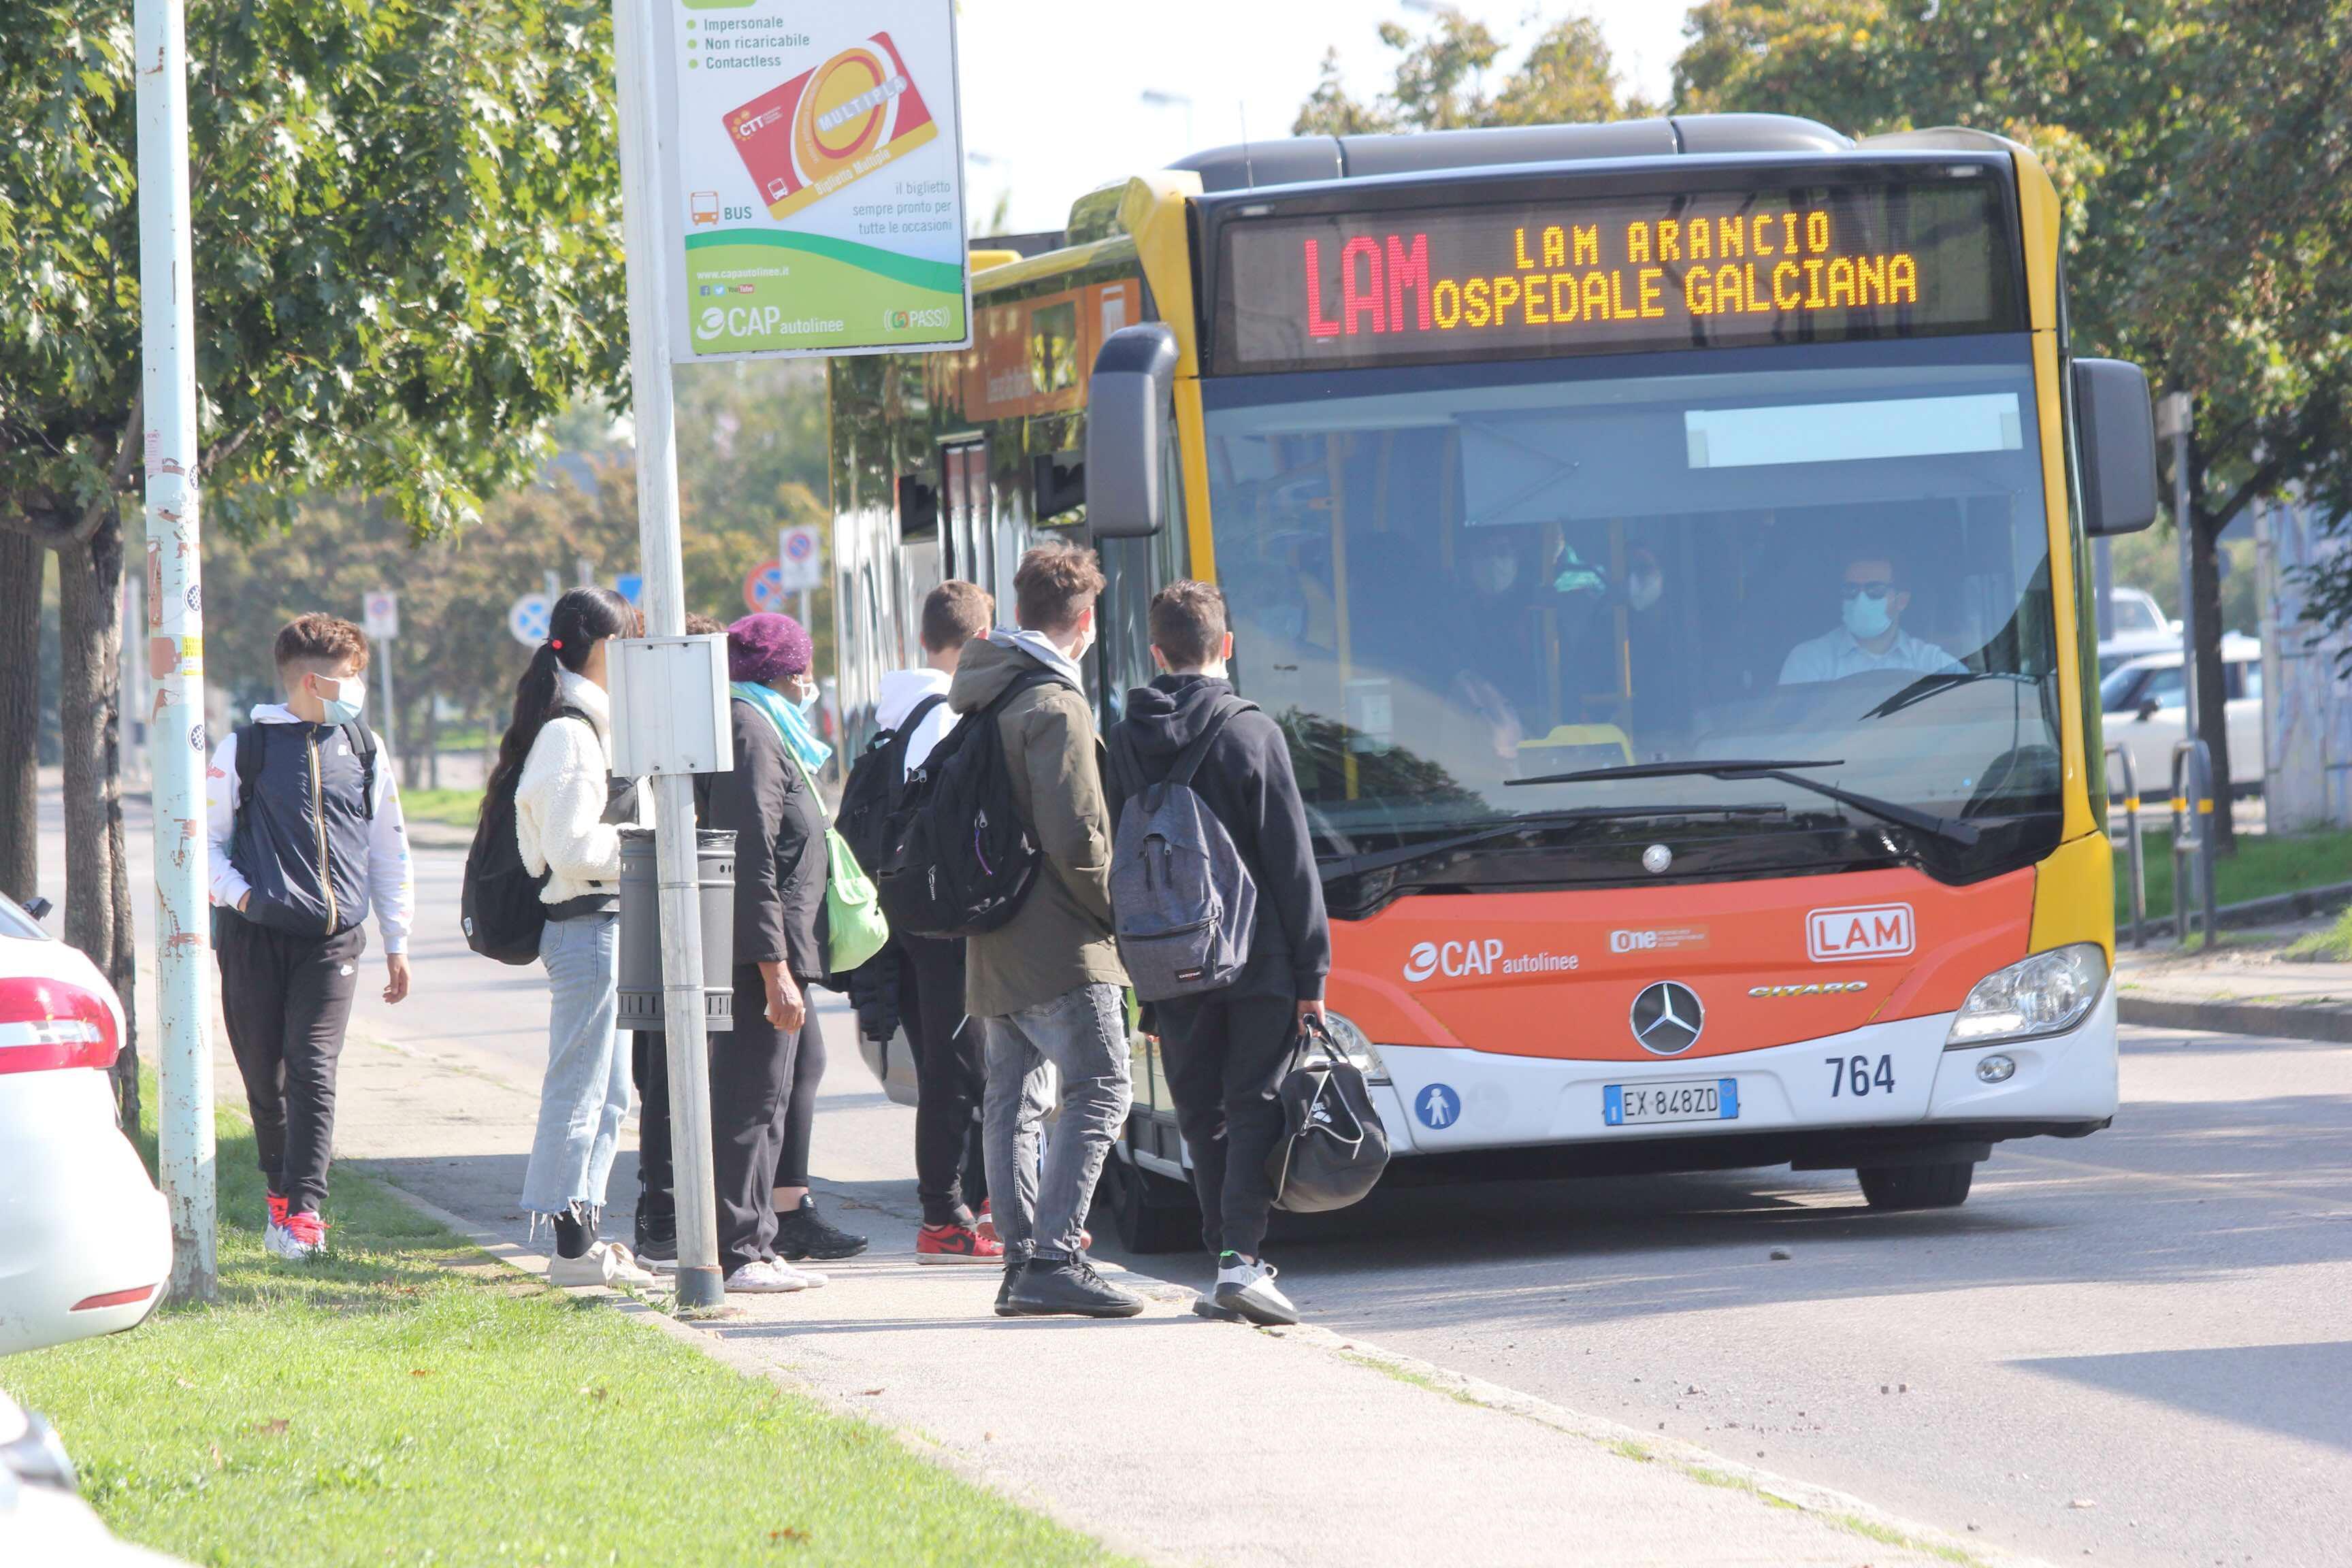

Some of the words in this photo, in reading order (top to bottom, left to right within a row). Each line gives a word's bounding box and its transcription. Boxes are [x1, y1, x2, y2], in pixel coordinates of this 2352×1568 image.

[704, 16, 783, 33] Impersonale
[705, 37, 730, 50] Non
[734, 33, 810, 49] ricaricabile
[706, 55, 781, 69] Contactless
[819, 78, 905, 131] MULTIPLA
[740, 116, 764, 136] CTT
[895, 182, 902, 195] il
[906, 180, 951, 196] biglietto
[724, 207, 752, 220] BUS
[853, 204, 893, 217] sempre
[897, 202, 932, 216] pronto
[935, 201, 951, 214] per
[859, 222, 885, 235] tutte
[889, 221, 899, 233] le
[902, 218, 952, 233] occasioni
[1515, 224, 1598, 270] LAM
[1628, 210, 1829, 263] ARANCIO
[697, 267, 789, 280] www.capautolinee.it
[1305, 233, 1430, 337] LAM
[1433, 267, 1665, 329] OSPEDALE
[1684, 253, 1917, 316] GALCIANA
[728, 306, 781, 337] CAP
[780, 317, 844, 334] autolinee
[1818, 915, 1901, 951] LAM
[1441, 938, 1503, 977] CAP
[1503, 951, 1579, 974] autolinee
[1748, 981, 1868, 998] CITARO
[1825, 1054, 1895, 1097] 764
